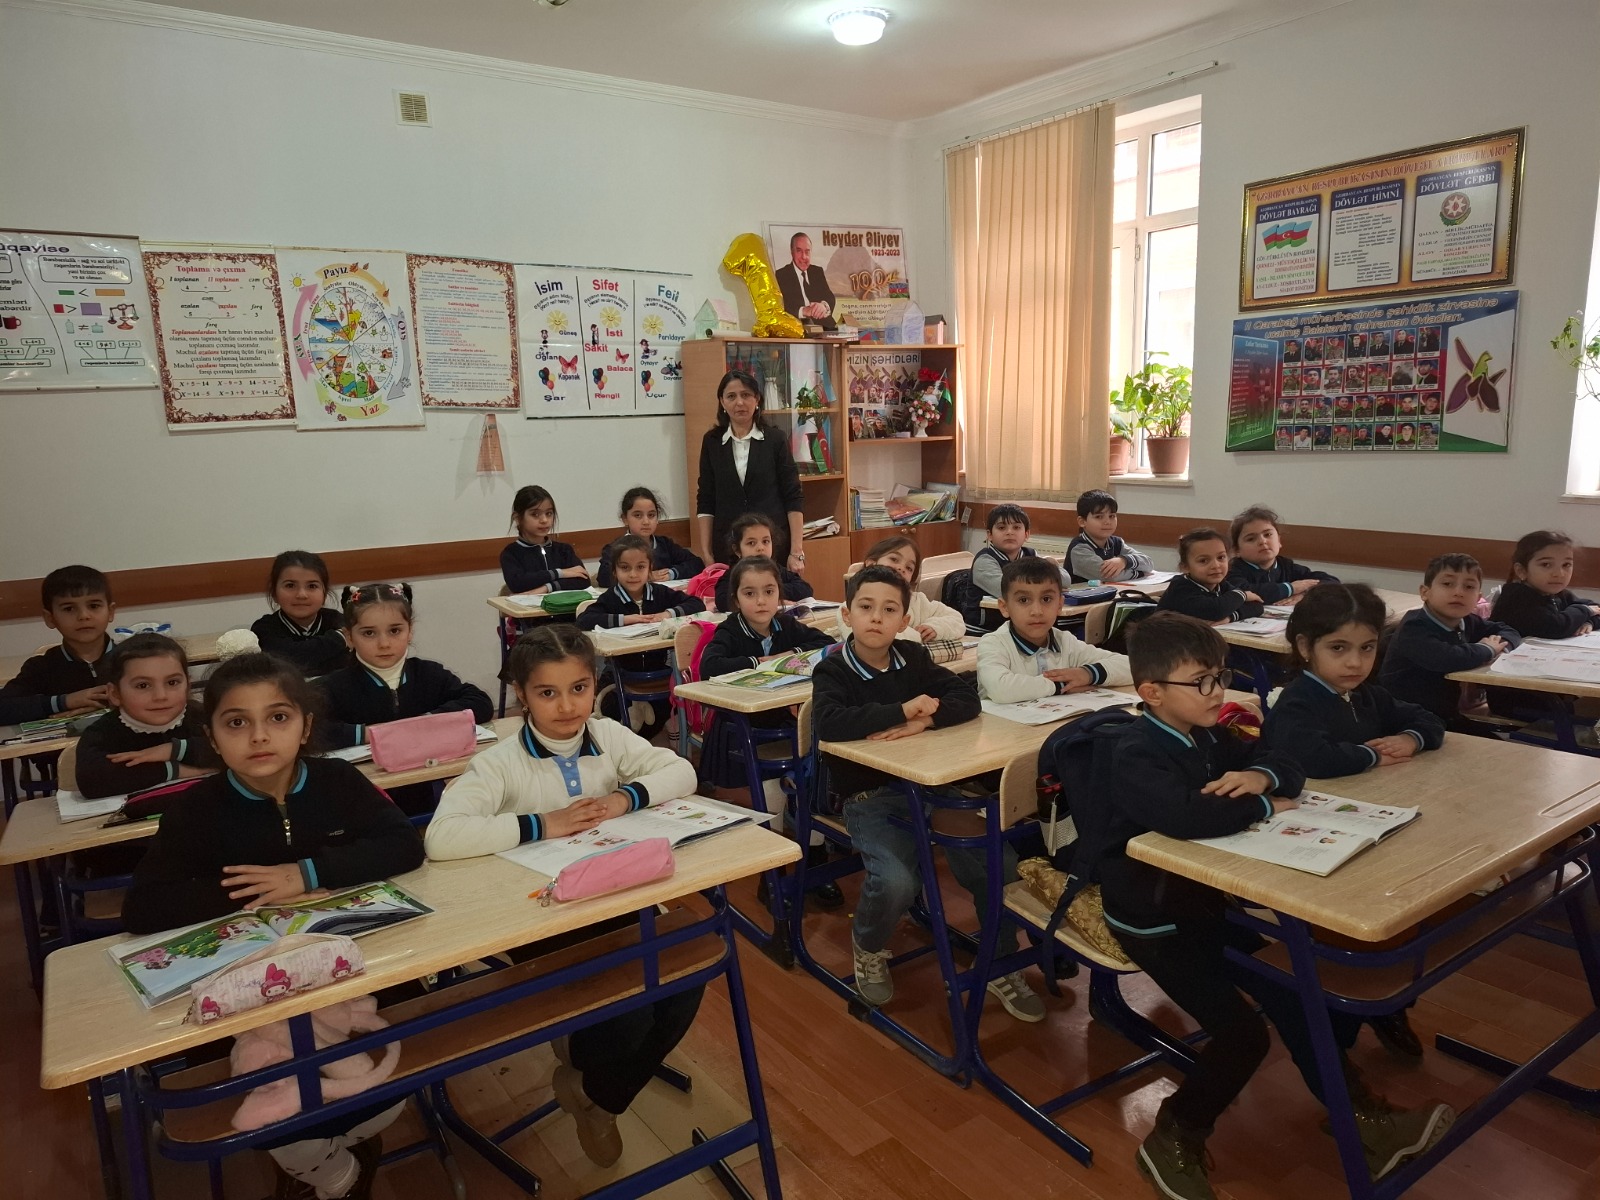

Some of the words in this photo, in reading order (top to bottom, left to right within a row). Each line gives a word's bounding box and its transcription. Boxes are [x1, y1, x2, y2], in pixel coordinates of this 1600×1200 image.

[1420, 178, 1462, 193] DÖVLƏT
[1464, 172, 1495, 186] GERBİ
[1335, 195, 1369, 209] DÖVLƏT
[1372, 188, 1400, 202] HİMNİ
[1260, 210, 1286, 221] DÖVLƏT
[1288, 204, 1317, 217] BAYRAĞI
[822, 230, 863, 248] Heydər
[866, 231, 900, 248] Əliyev
[176, 266, 210, 274] Toplama
[324, 267, 348, 279] Payız
[534, 280, 563, 295] İsim
[592, 279, 619, 292] Sifət
[658, 285, 680, 302] Feil
[1253, 317, 1299, 330] Qarabağ
[1300, 309, 1384, 326] müharibəsində
[1387, 302, 1434, 319] şəhidlik
[1437, 297, 1499, 311] zirvəsinə
[1354, 318, 1409, 332] qəhrəman
[584, 343, 608, 352] Sakit
[871, 354, 920, 366] ŞƏHİDLƏRİ
[361, 404, 380, 416] Yaz
